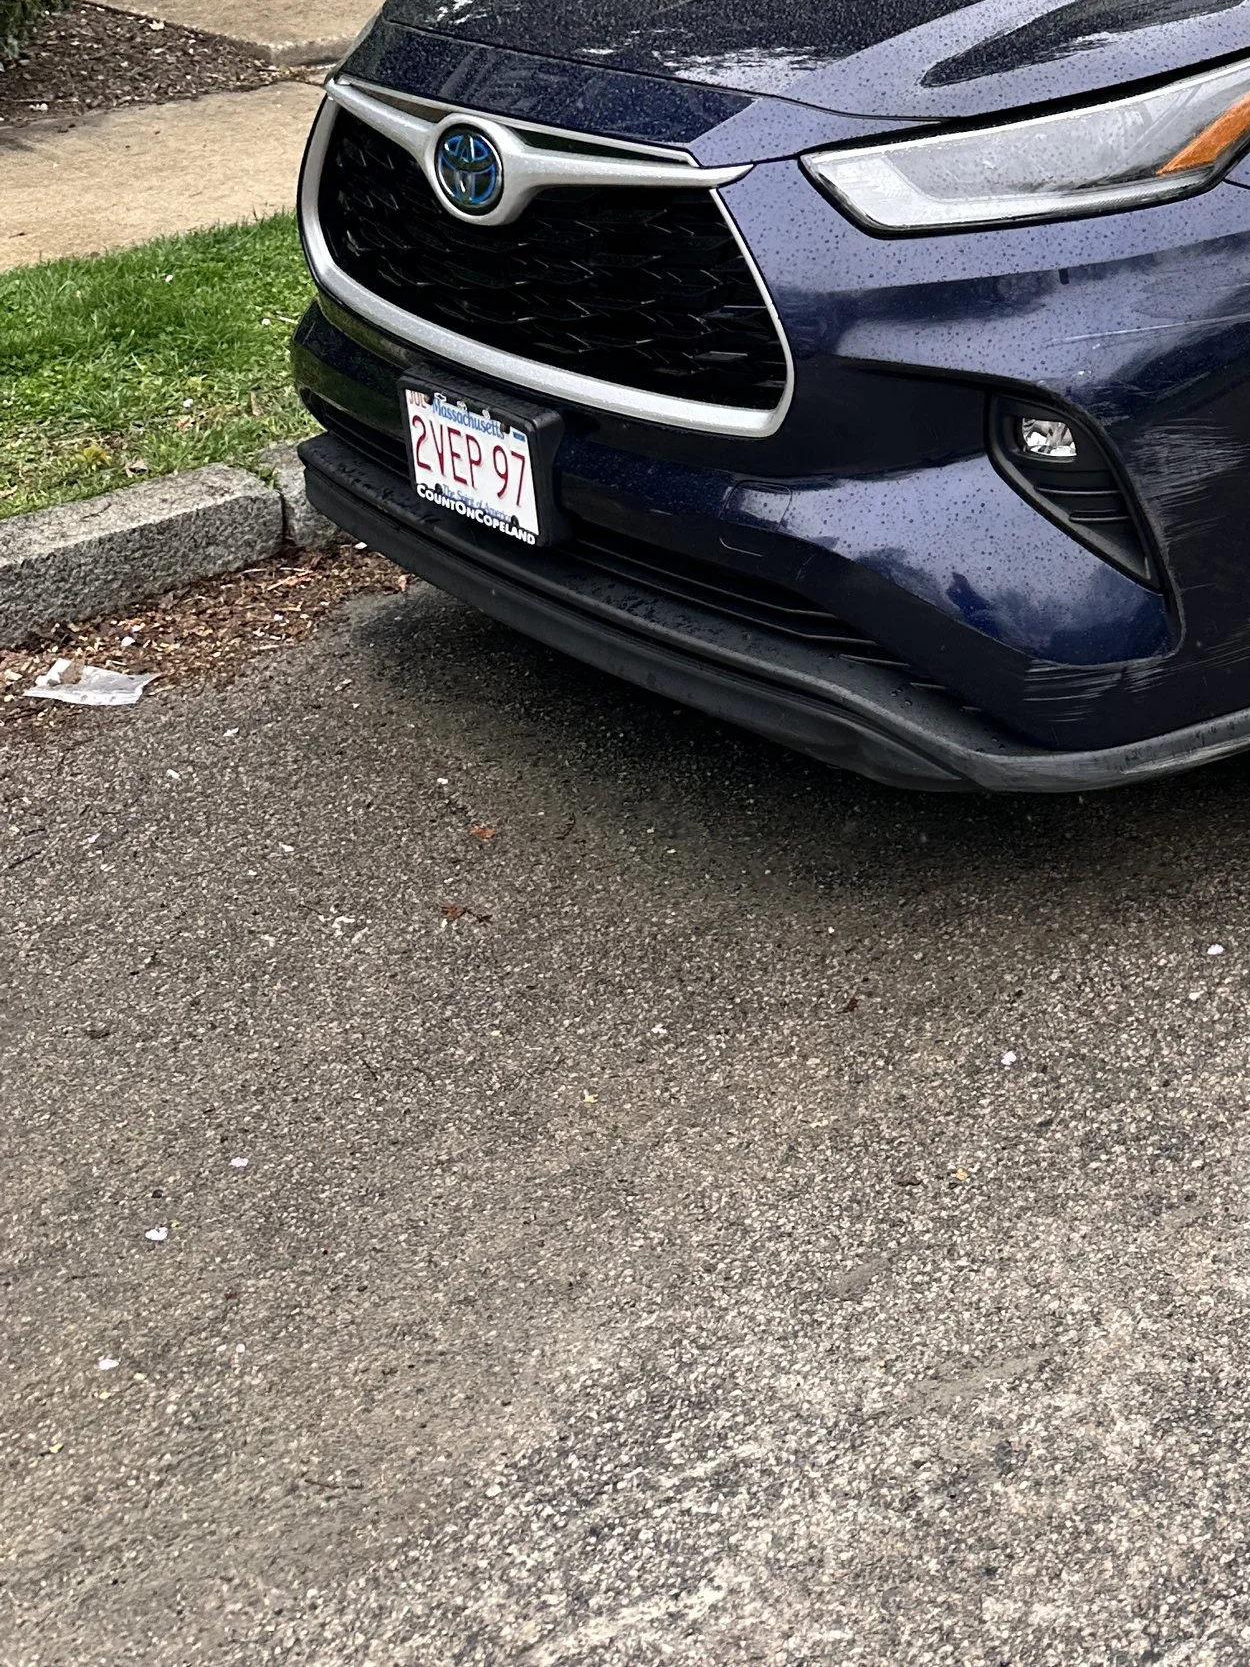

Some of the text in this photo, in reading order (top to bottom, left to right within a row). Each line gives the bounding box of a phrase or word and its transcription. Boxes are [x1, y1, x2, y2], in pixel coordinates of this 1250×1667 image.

[432, 399, 505, 440] Massachusetts
[412, 415, 526, 507] 2VEP 97
[443, 484, 456, 499] The
[457, 490, 475, 506] Spirit
[483, 502, 512, 521] America
